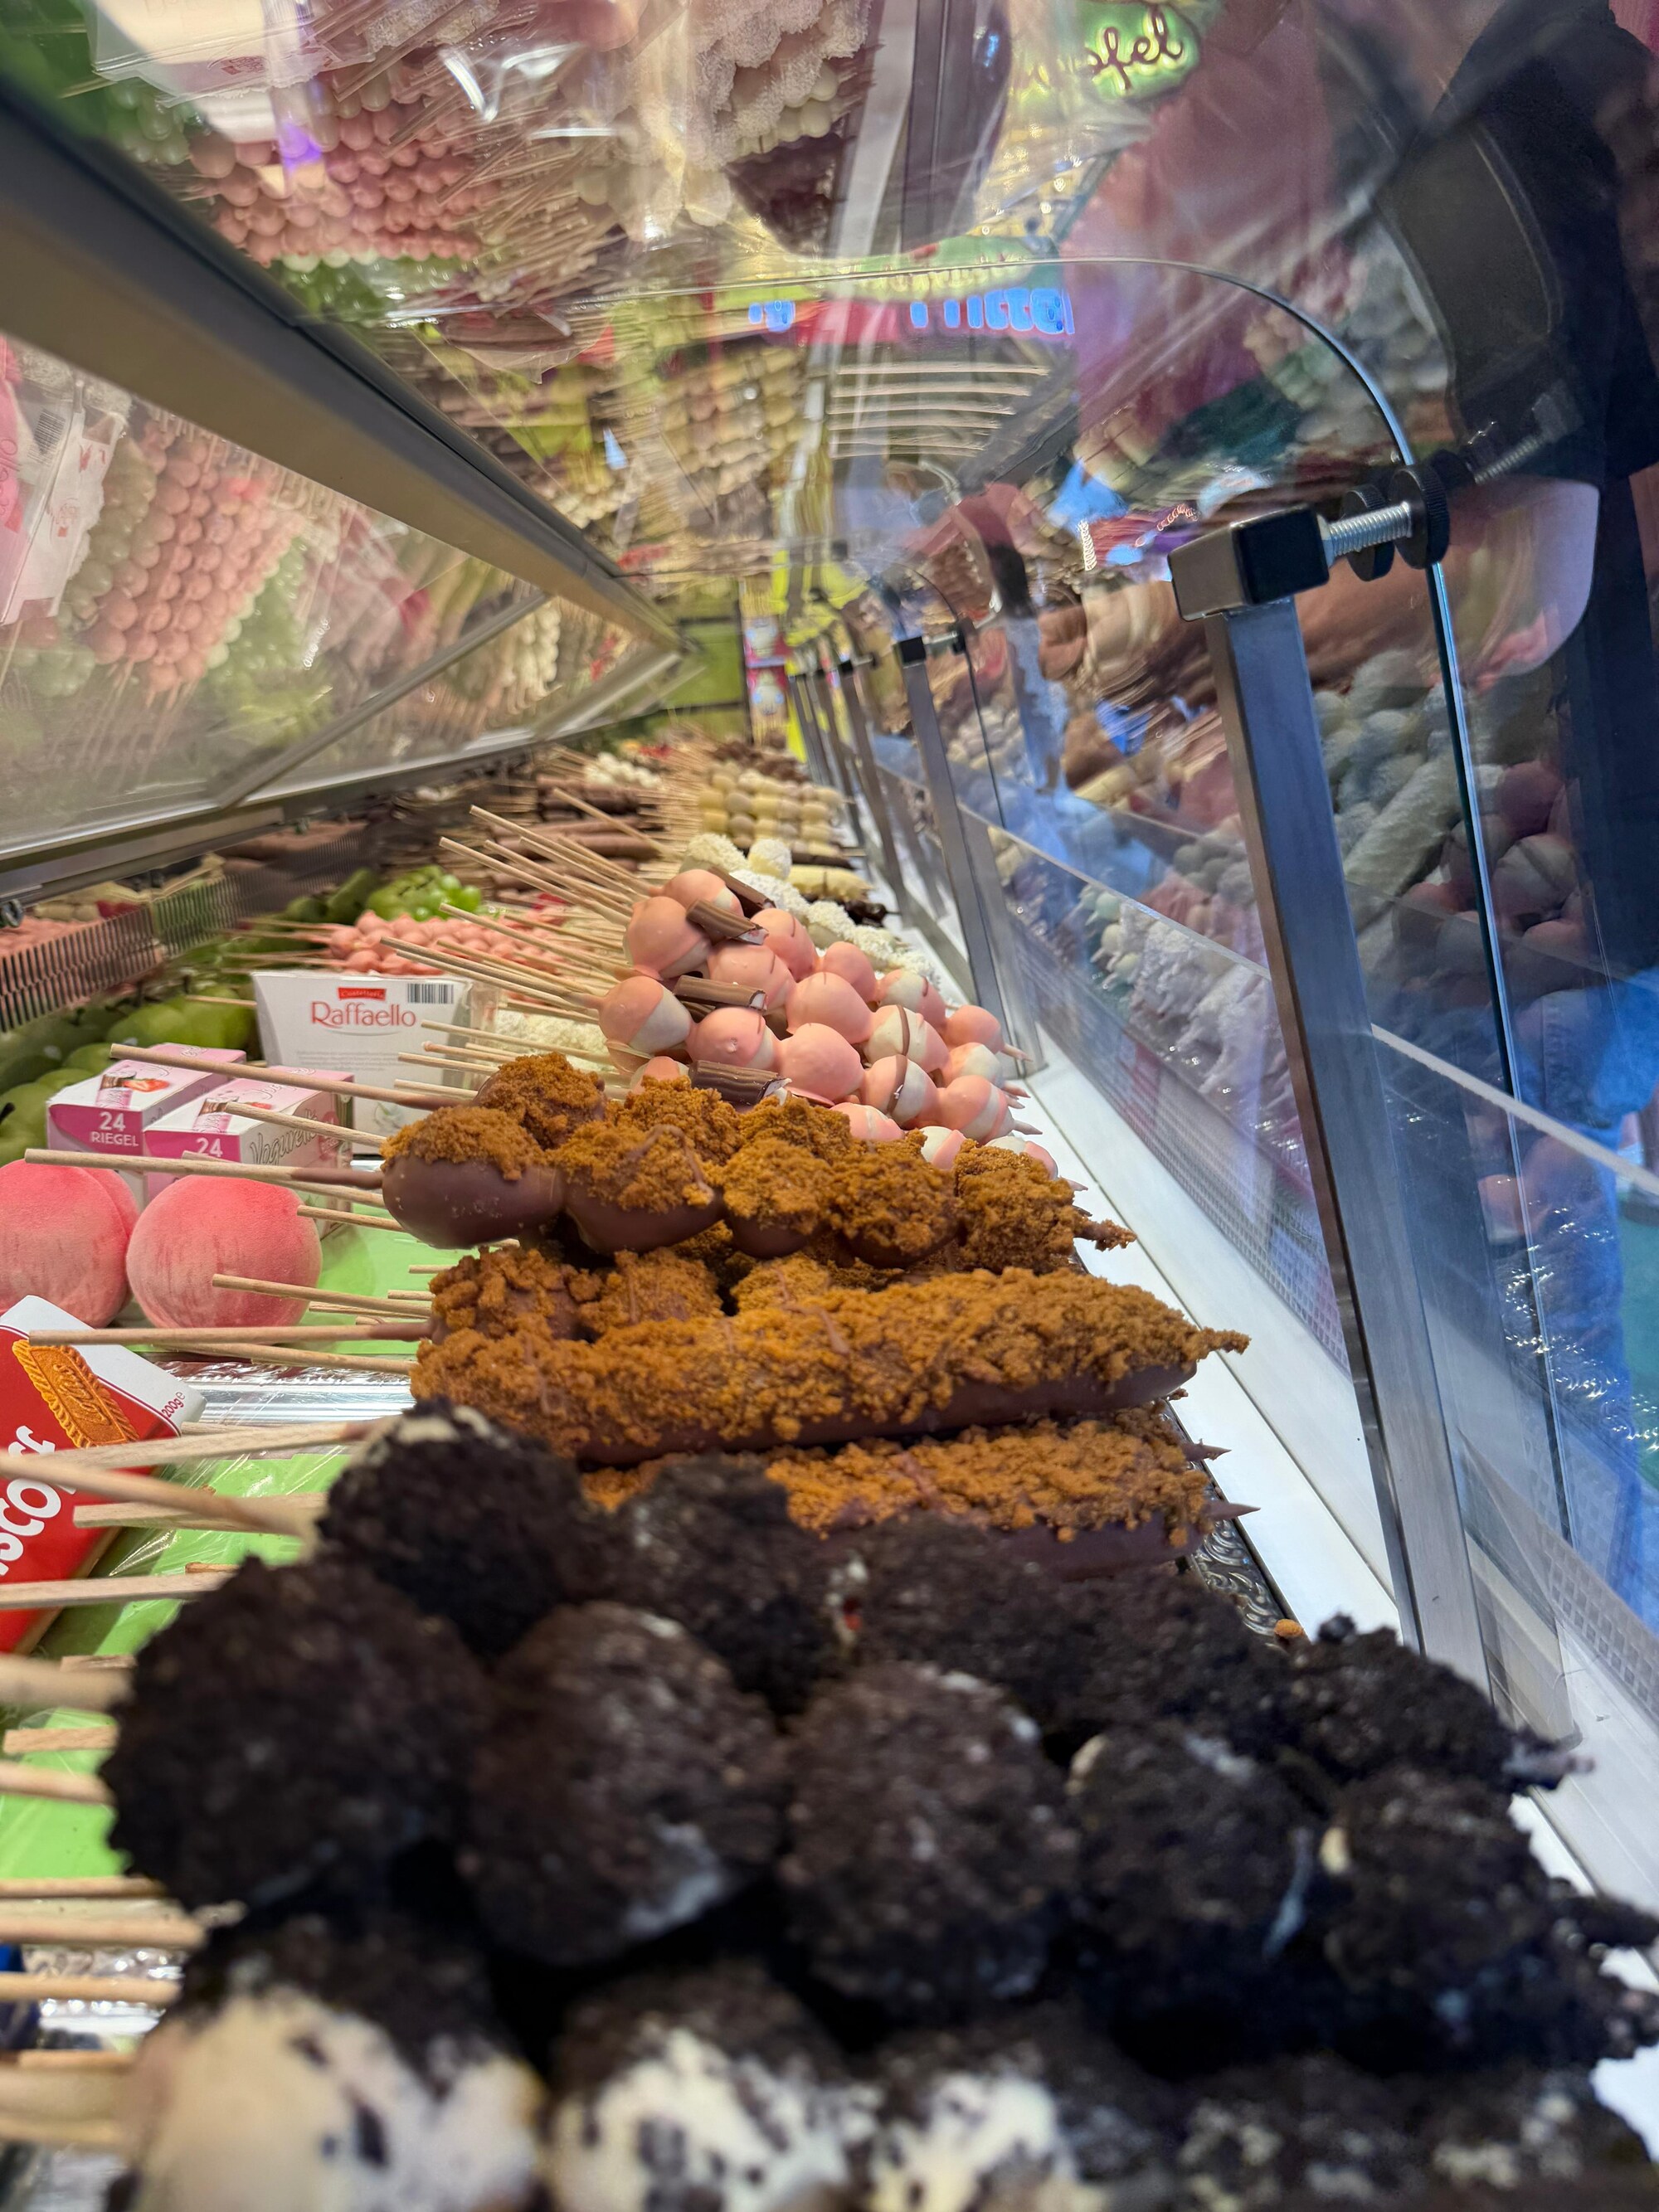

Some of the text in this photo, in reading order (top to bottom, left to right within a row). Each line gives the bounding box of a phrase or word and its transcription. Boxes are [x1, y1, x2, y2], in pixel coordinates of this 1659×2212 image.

[311, 1000, 416, 1029] Raffaello
[99, 1111, 126, 1131] 24
[90, 1130, 139, 1147] RIEGEL
[196, 1136, 223, 1158] 24
